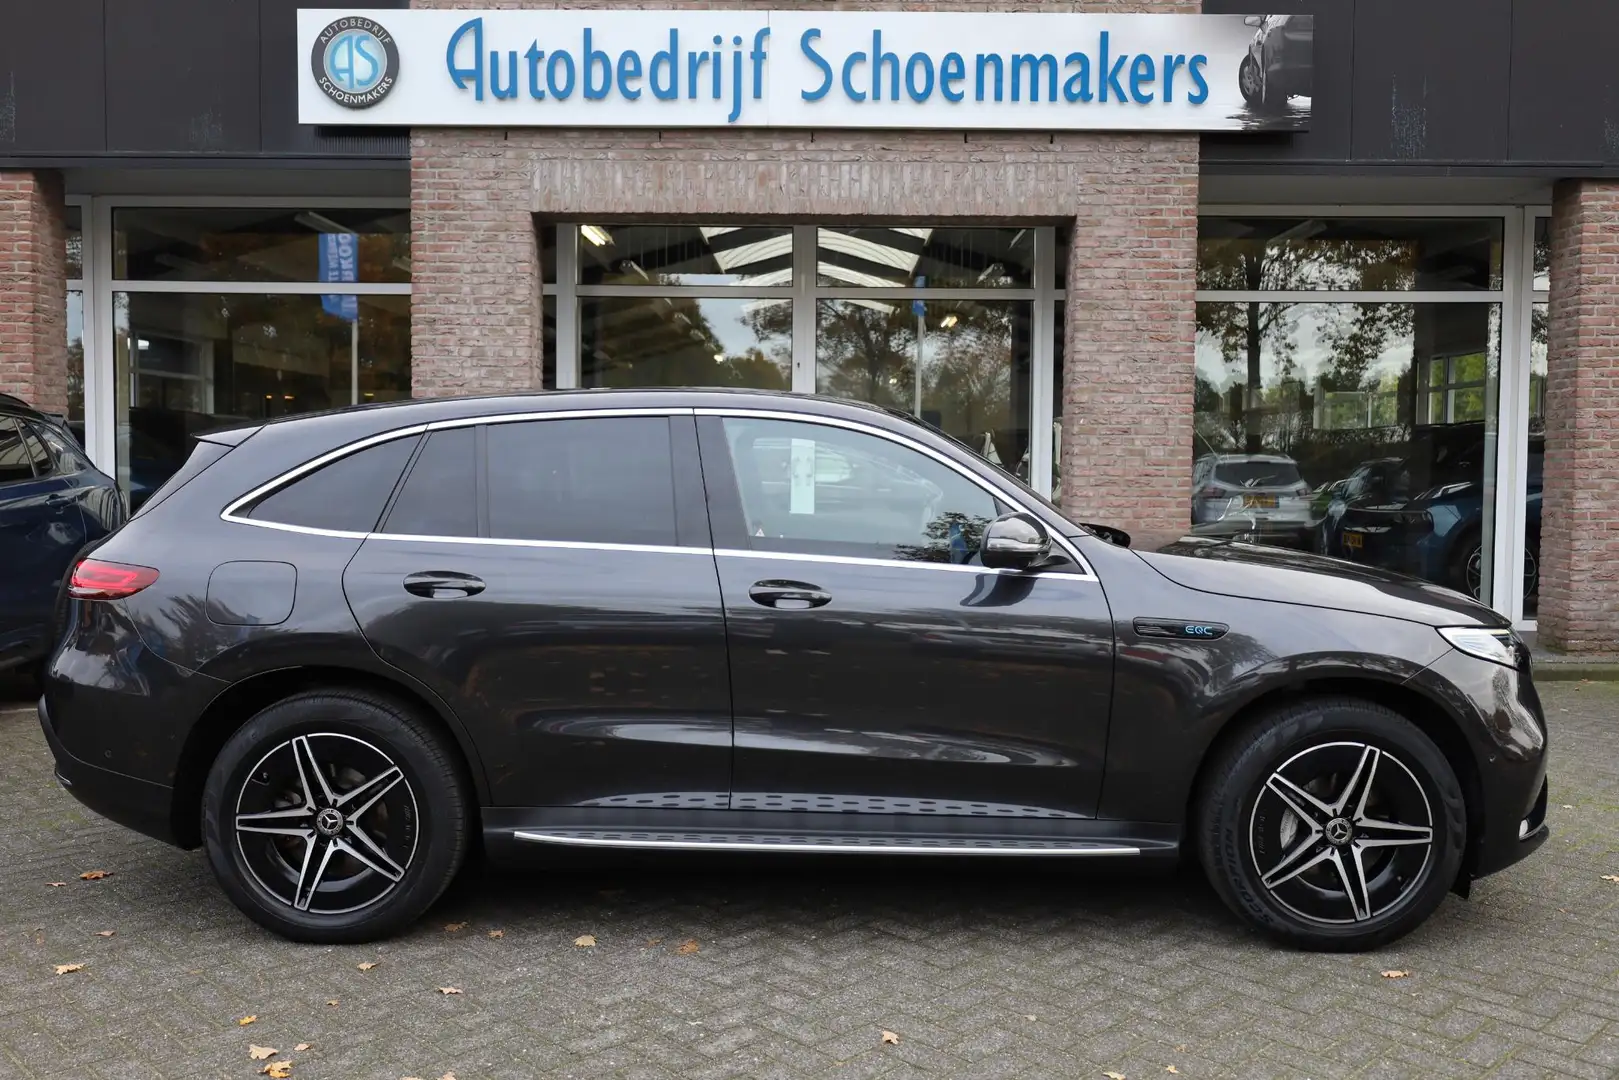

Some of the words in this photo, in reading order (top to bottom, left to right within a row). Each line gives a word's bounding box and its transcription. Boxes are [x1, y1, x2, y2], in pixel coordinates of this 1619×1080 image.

[320, 18, 392, 44] AUTOBEDRIJF
[446, 17, 771, 123] Autobedrijf
[799, 28, 1210, 105] Schoenmakers
[318, 76, 393, 104] SCHOENMAKERS
[1185, 625, 1213, 635] EQC
